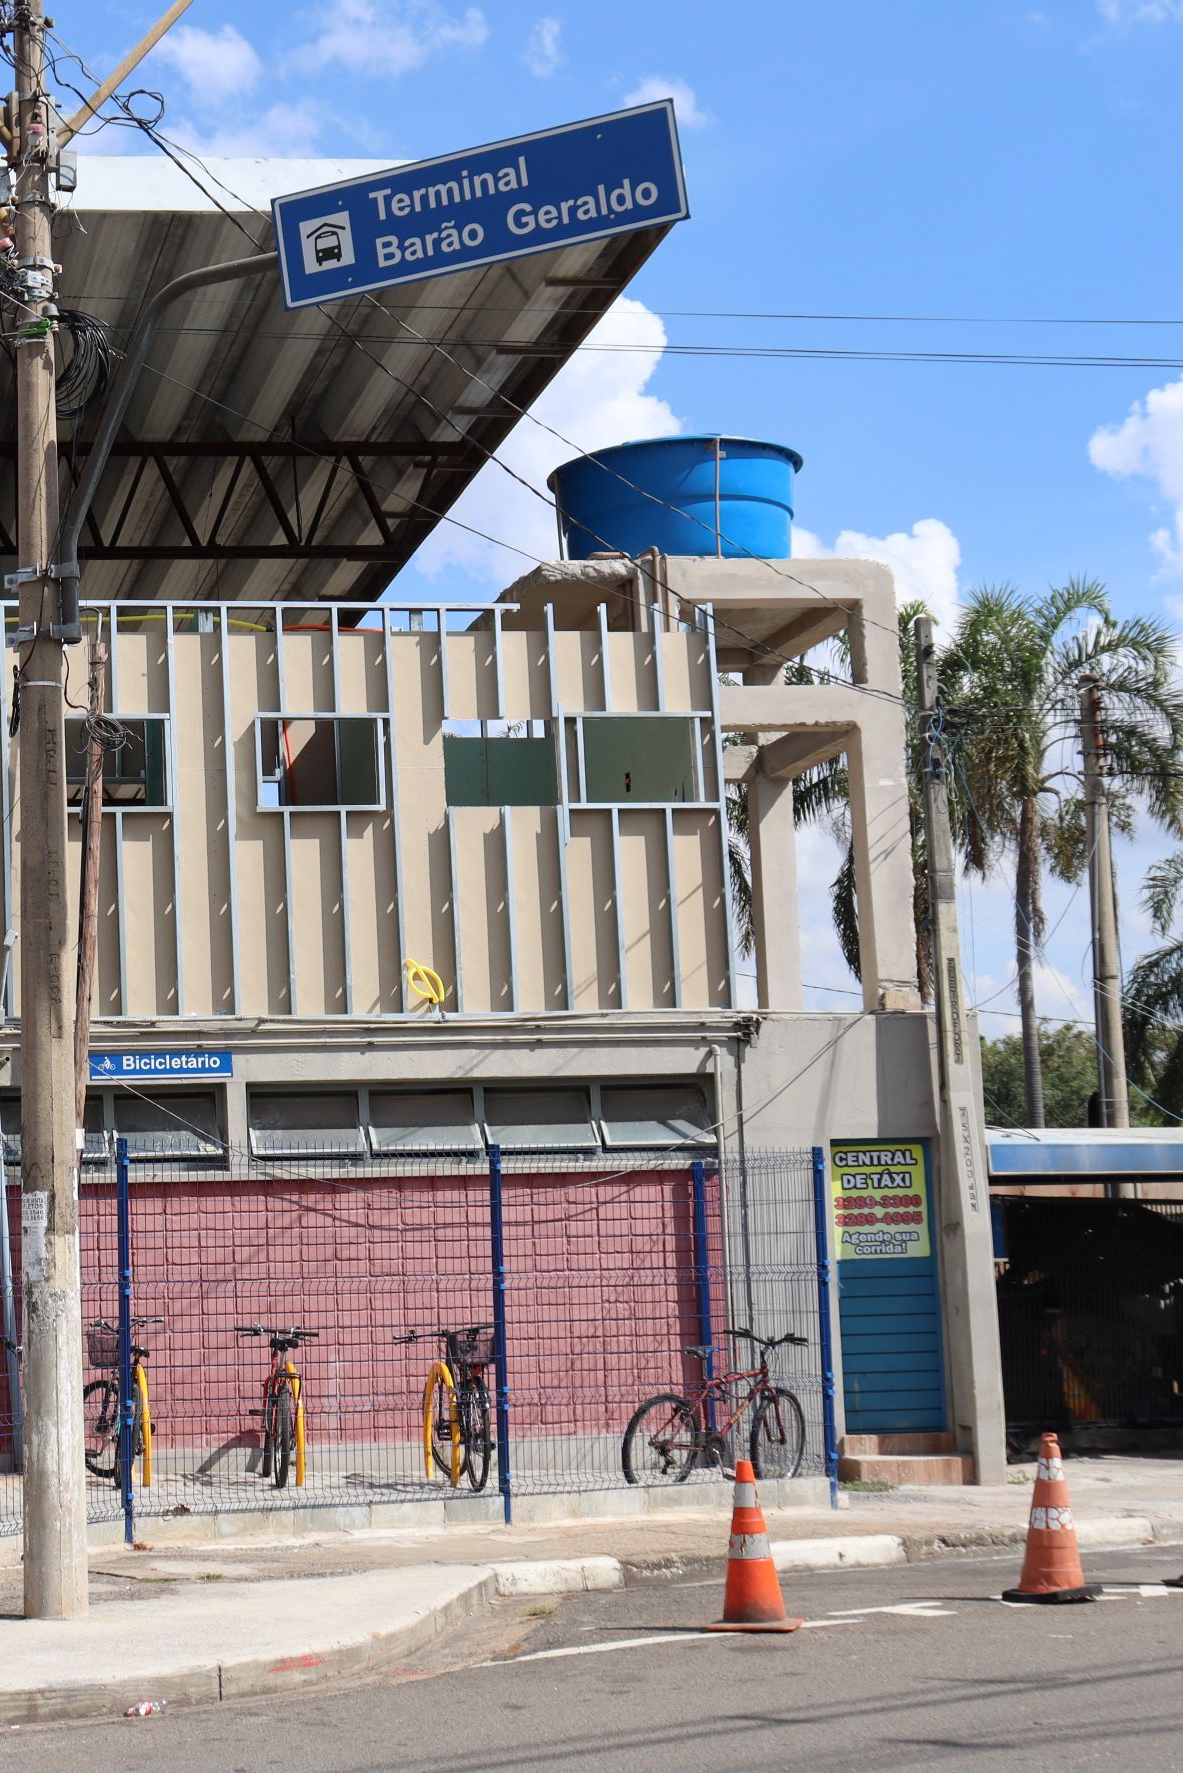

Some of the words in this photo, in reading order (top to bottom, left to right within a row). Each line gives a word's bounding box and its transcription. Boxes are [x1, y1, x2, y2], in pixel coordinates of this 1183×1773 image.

[369, 156, 529, 221] Terminal
[375, 219, 485, 268] Barão
[506, 178, 659, 235] Geraldo
[122, 1053, 221, 1070] Bicicletário
[834, 1150, 917, 1167] CENTRAL
[842, 1173, 868, 1189] DE
[870, 1169, 912, 1189] TÁXI
[835, 1211, 923, 1227] 3289-4995
[842, 1231, 892, 1245] Agende
[893, 1231, 919, 1241] sua
[855, 1241, 907, 1255] corrida!
